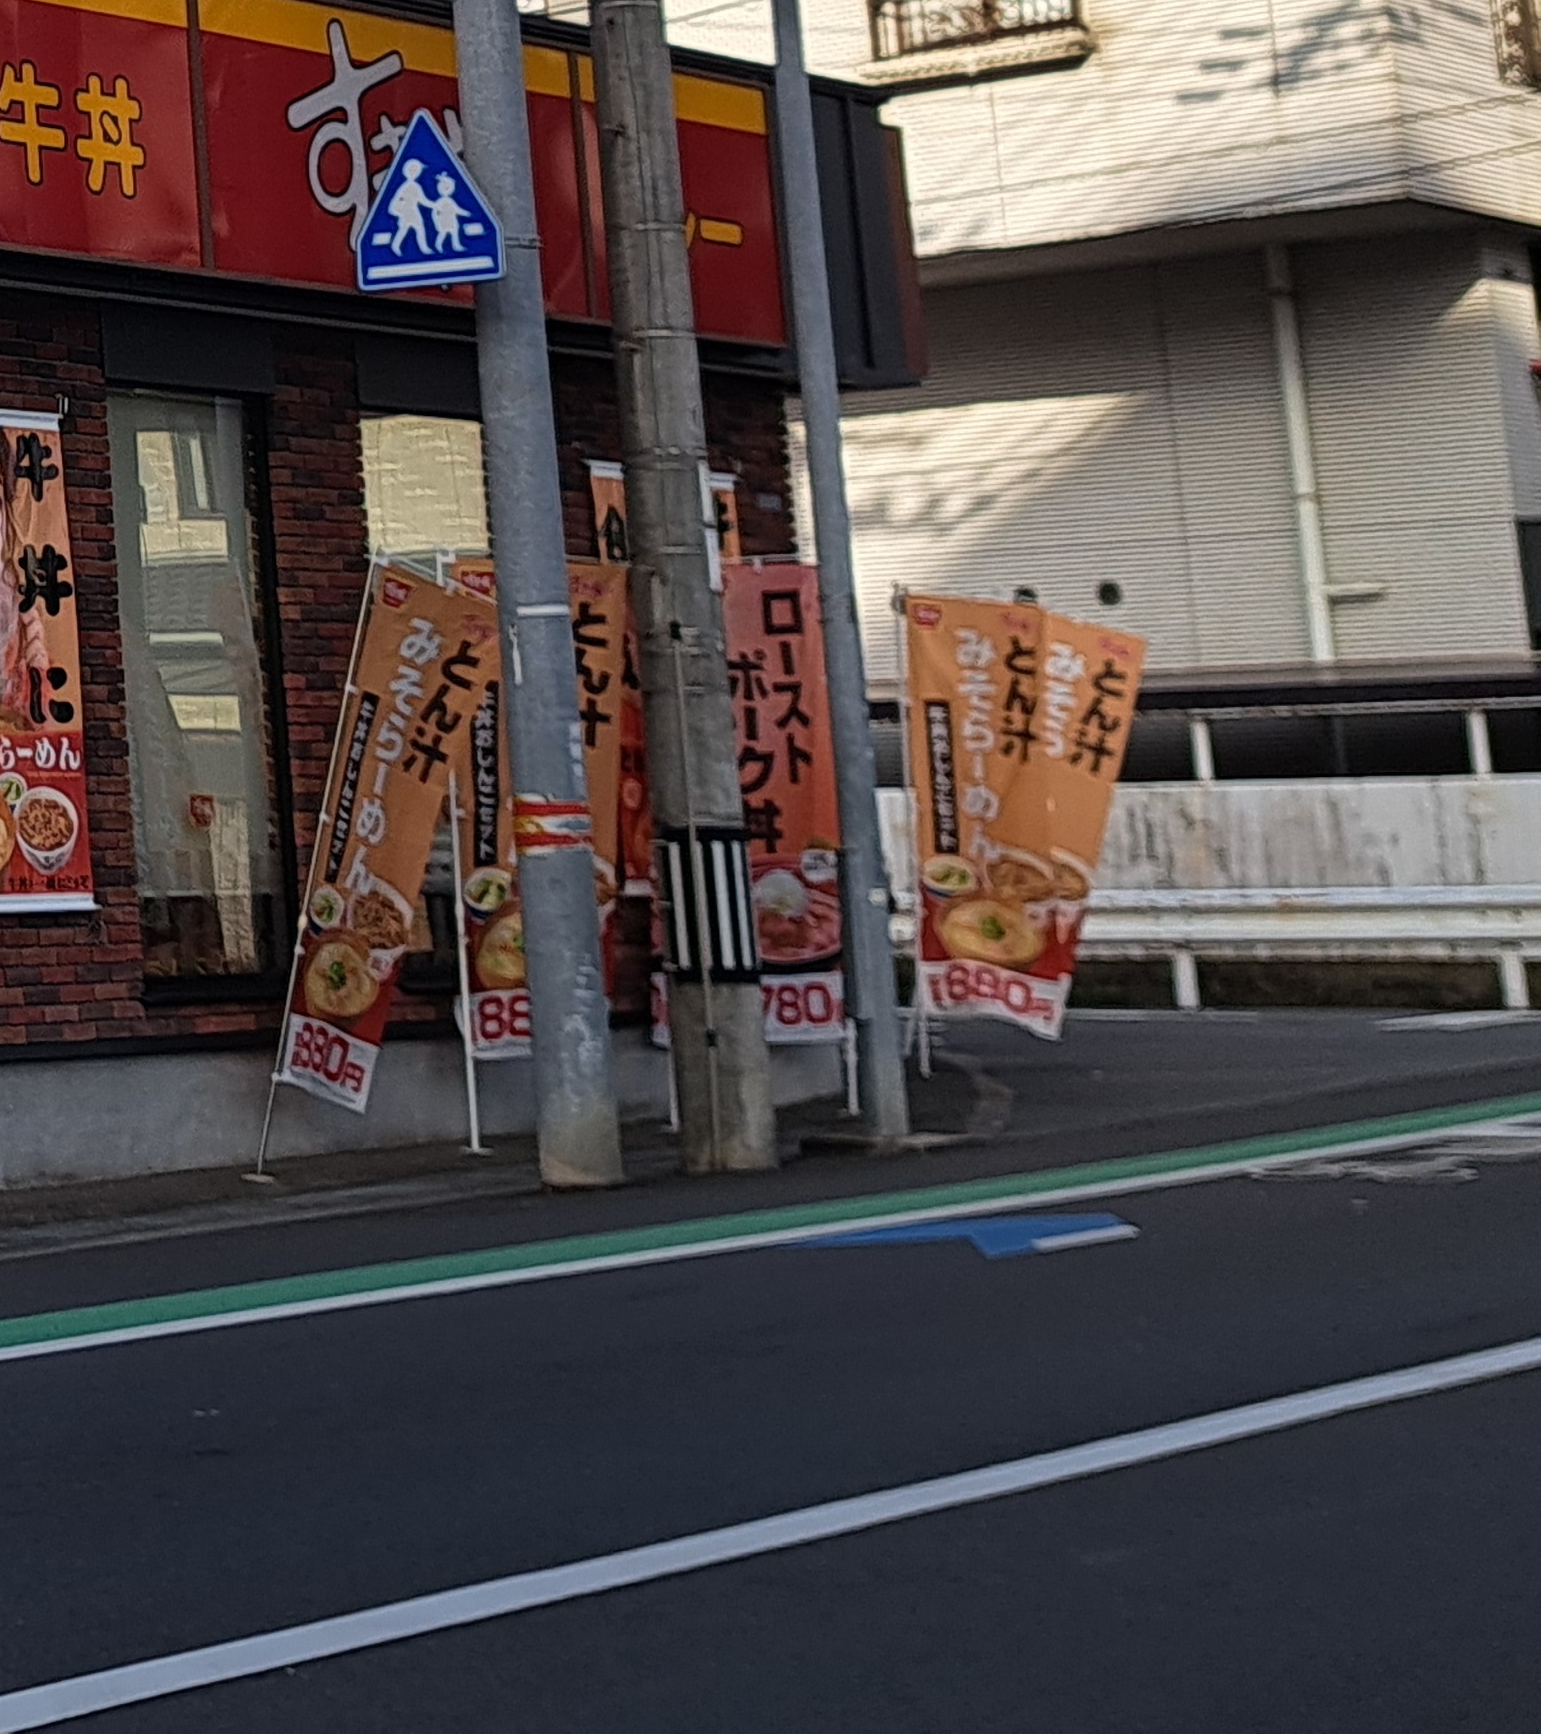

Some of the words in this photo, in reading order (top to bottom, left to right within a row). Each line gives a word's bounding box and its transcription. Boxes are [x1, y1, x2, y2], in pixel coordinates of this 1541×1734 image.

[401, 639, 481, 785] とん汁
[761, 589, 813, 784] ロースト
[1001, 635, 1039, 764] とん汁
[1071, 658, 1128, 778] とん汁
